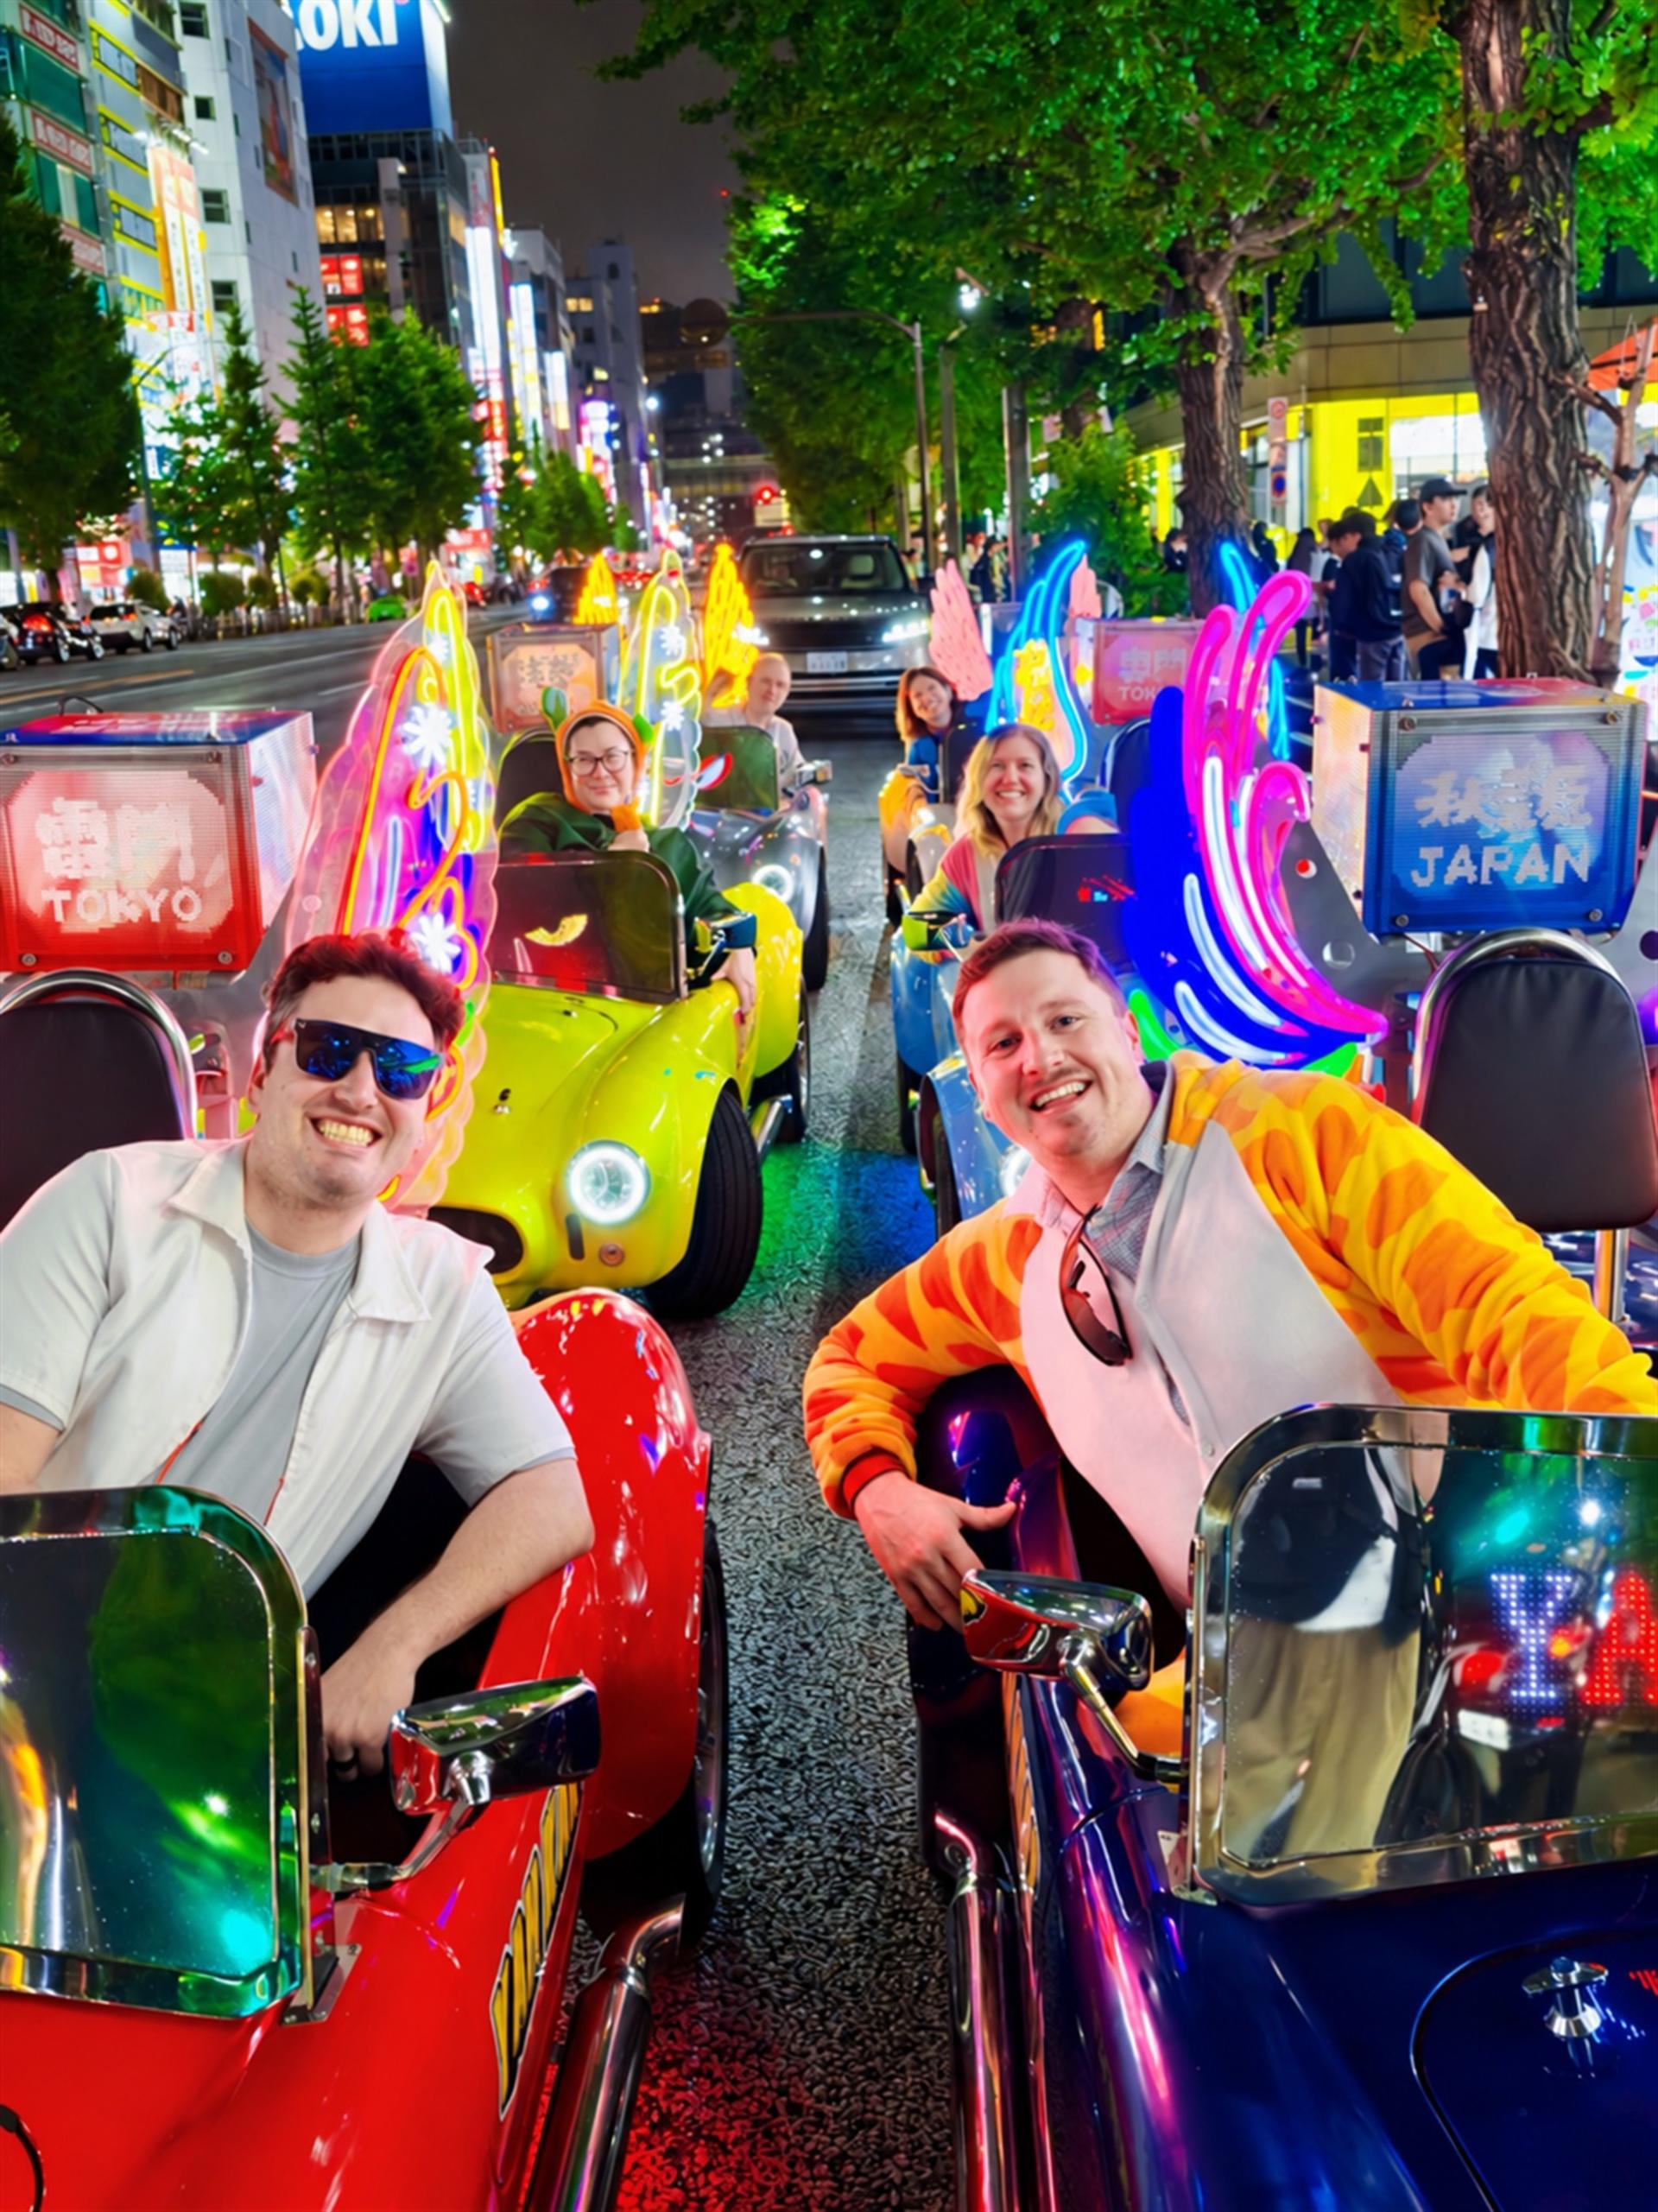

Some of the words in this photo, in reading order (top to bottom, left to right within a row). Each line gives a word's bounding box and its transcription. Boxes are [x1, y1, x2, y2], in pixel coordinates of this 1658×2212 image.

[281, 0, 398, 51] OKI
[1411, 843, 1589, 887] JAPAN
[41, 886, 202, 922] TOKYO
